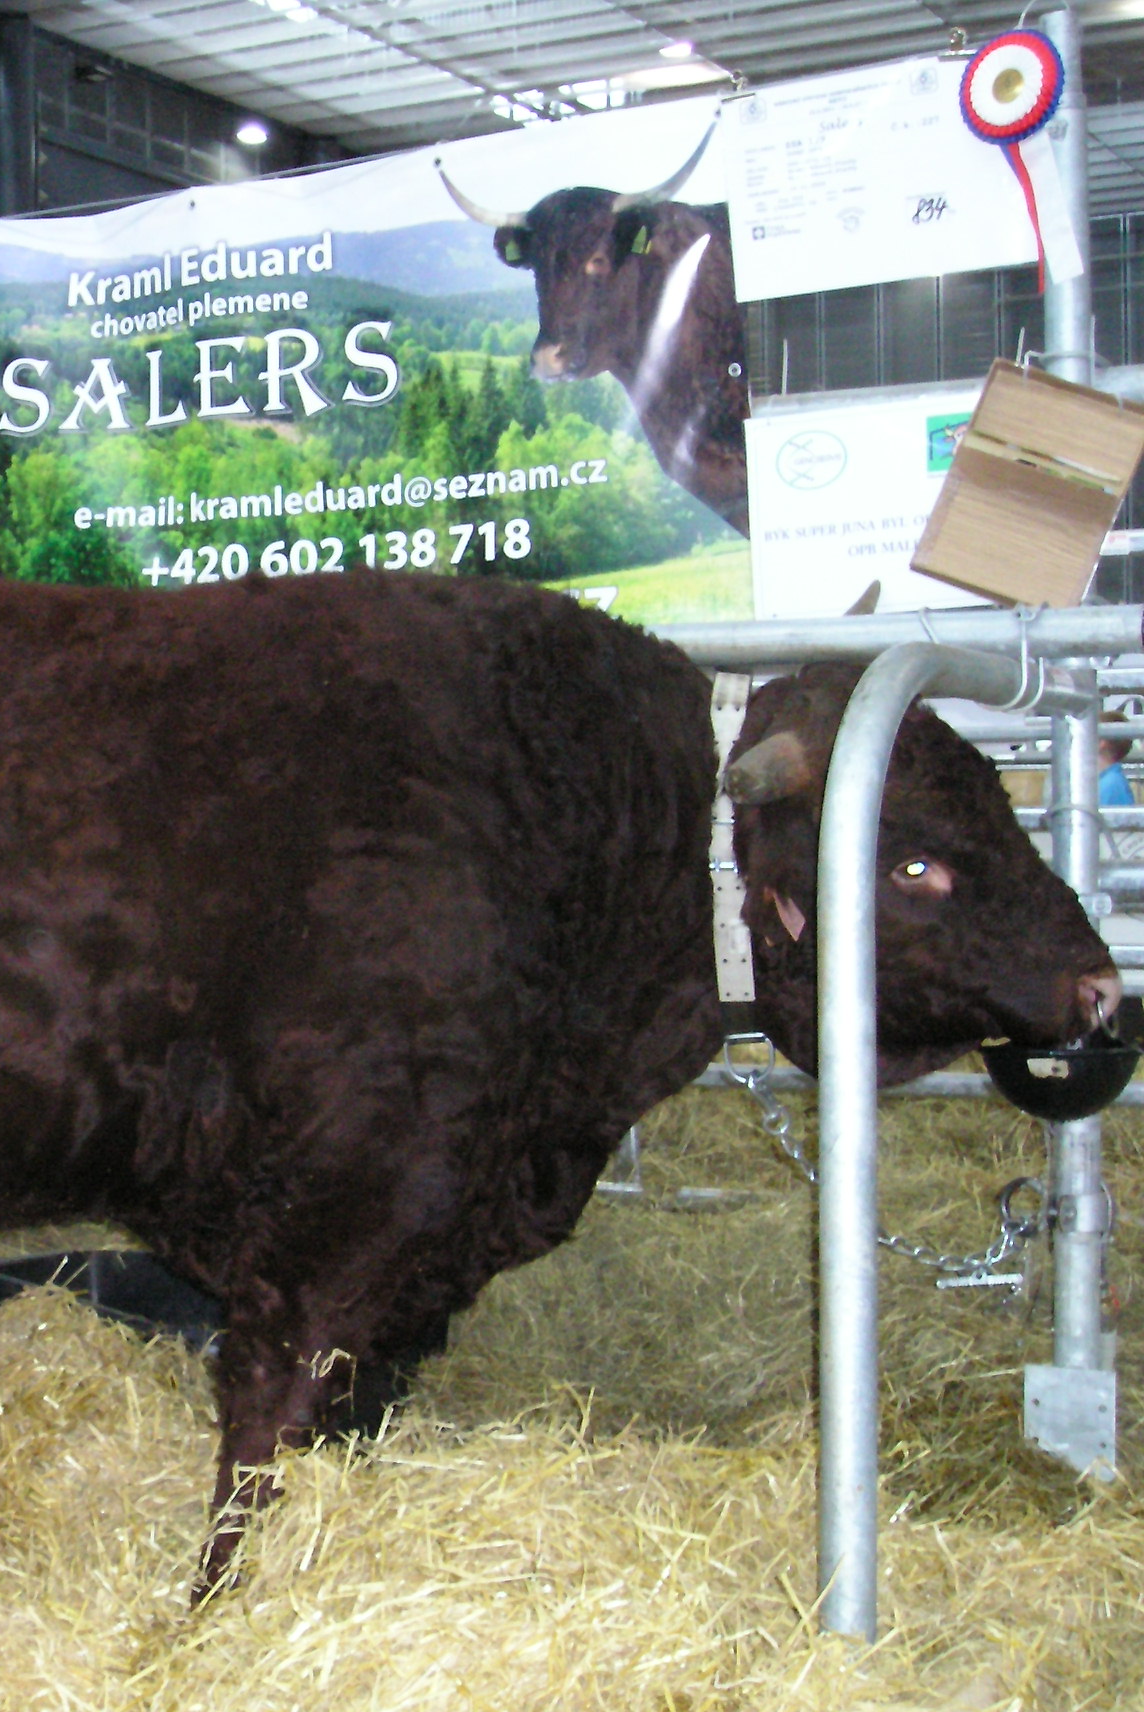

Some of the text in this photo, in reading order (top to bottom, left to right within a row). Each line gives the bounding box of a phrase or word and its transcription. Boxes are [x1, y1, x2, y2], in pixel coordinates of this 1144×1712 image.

[67, 231, 334, 307] Kraml Eduard
[90, 290, 309, 339] chovatel plemene
[73, 459, 608, 529] e-mail: kramleduard@seznam.cz
[142, 518, 532, 586] +420 602 138 718
[795, 523, 837, 538] SUPER
